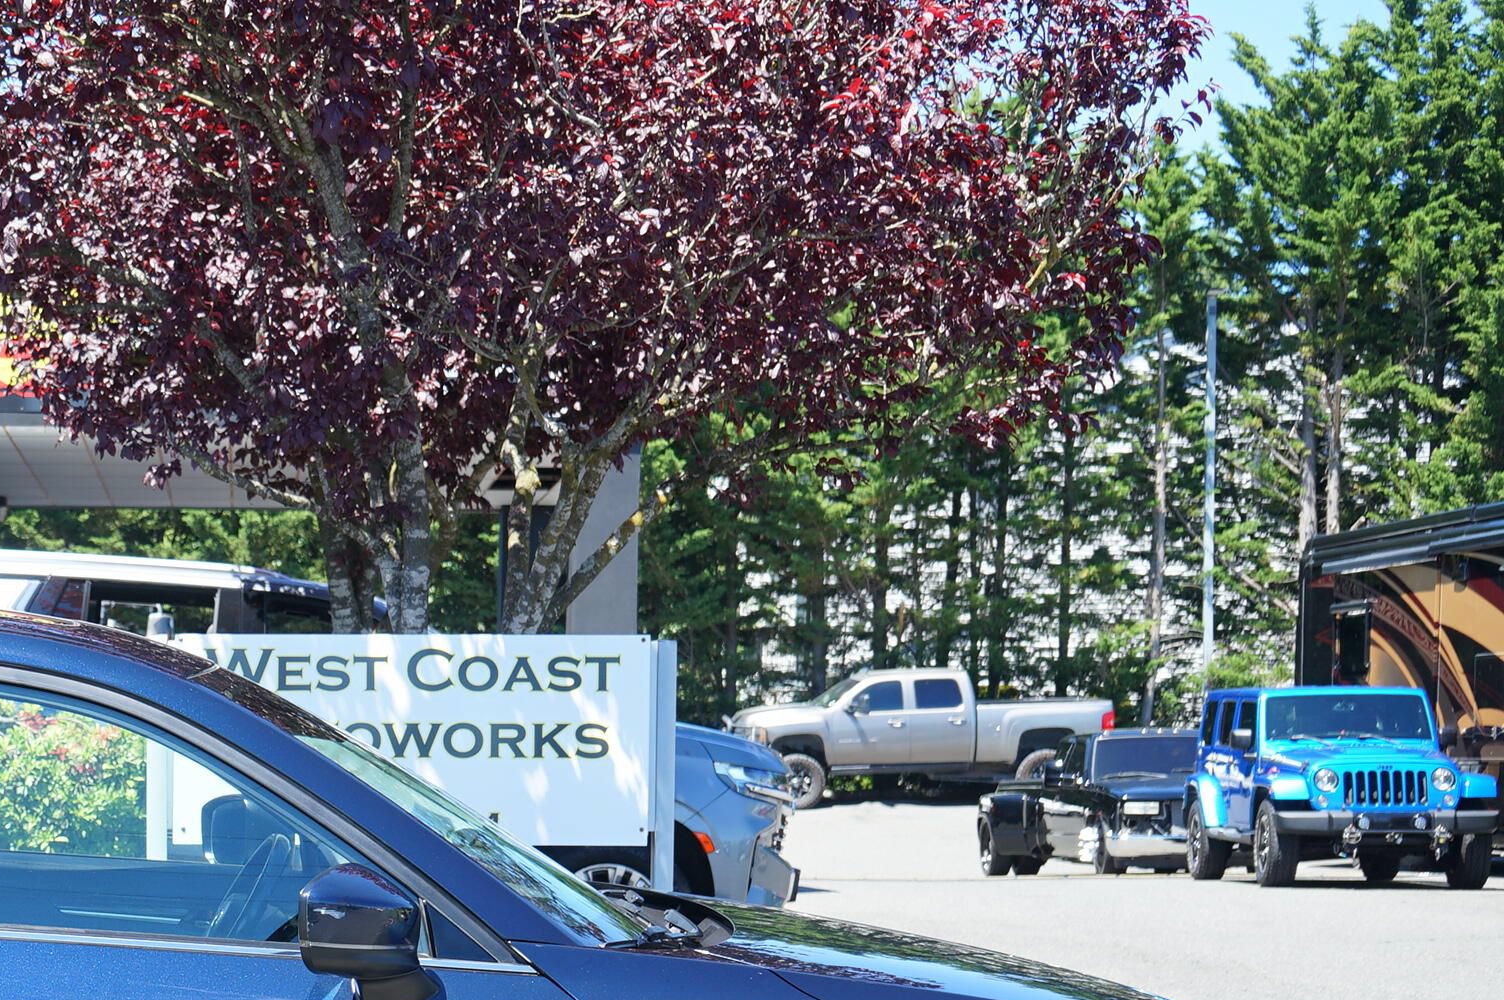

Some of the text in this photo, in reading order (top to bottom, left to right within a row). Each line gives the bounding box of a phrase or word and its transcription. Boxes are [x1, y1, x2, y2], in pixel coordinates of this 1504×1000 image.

[205, 648, 621, 692] WEST COAST
[335, 721, 610, 759] OWORKS
